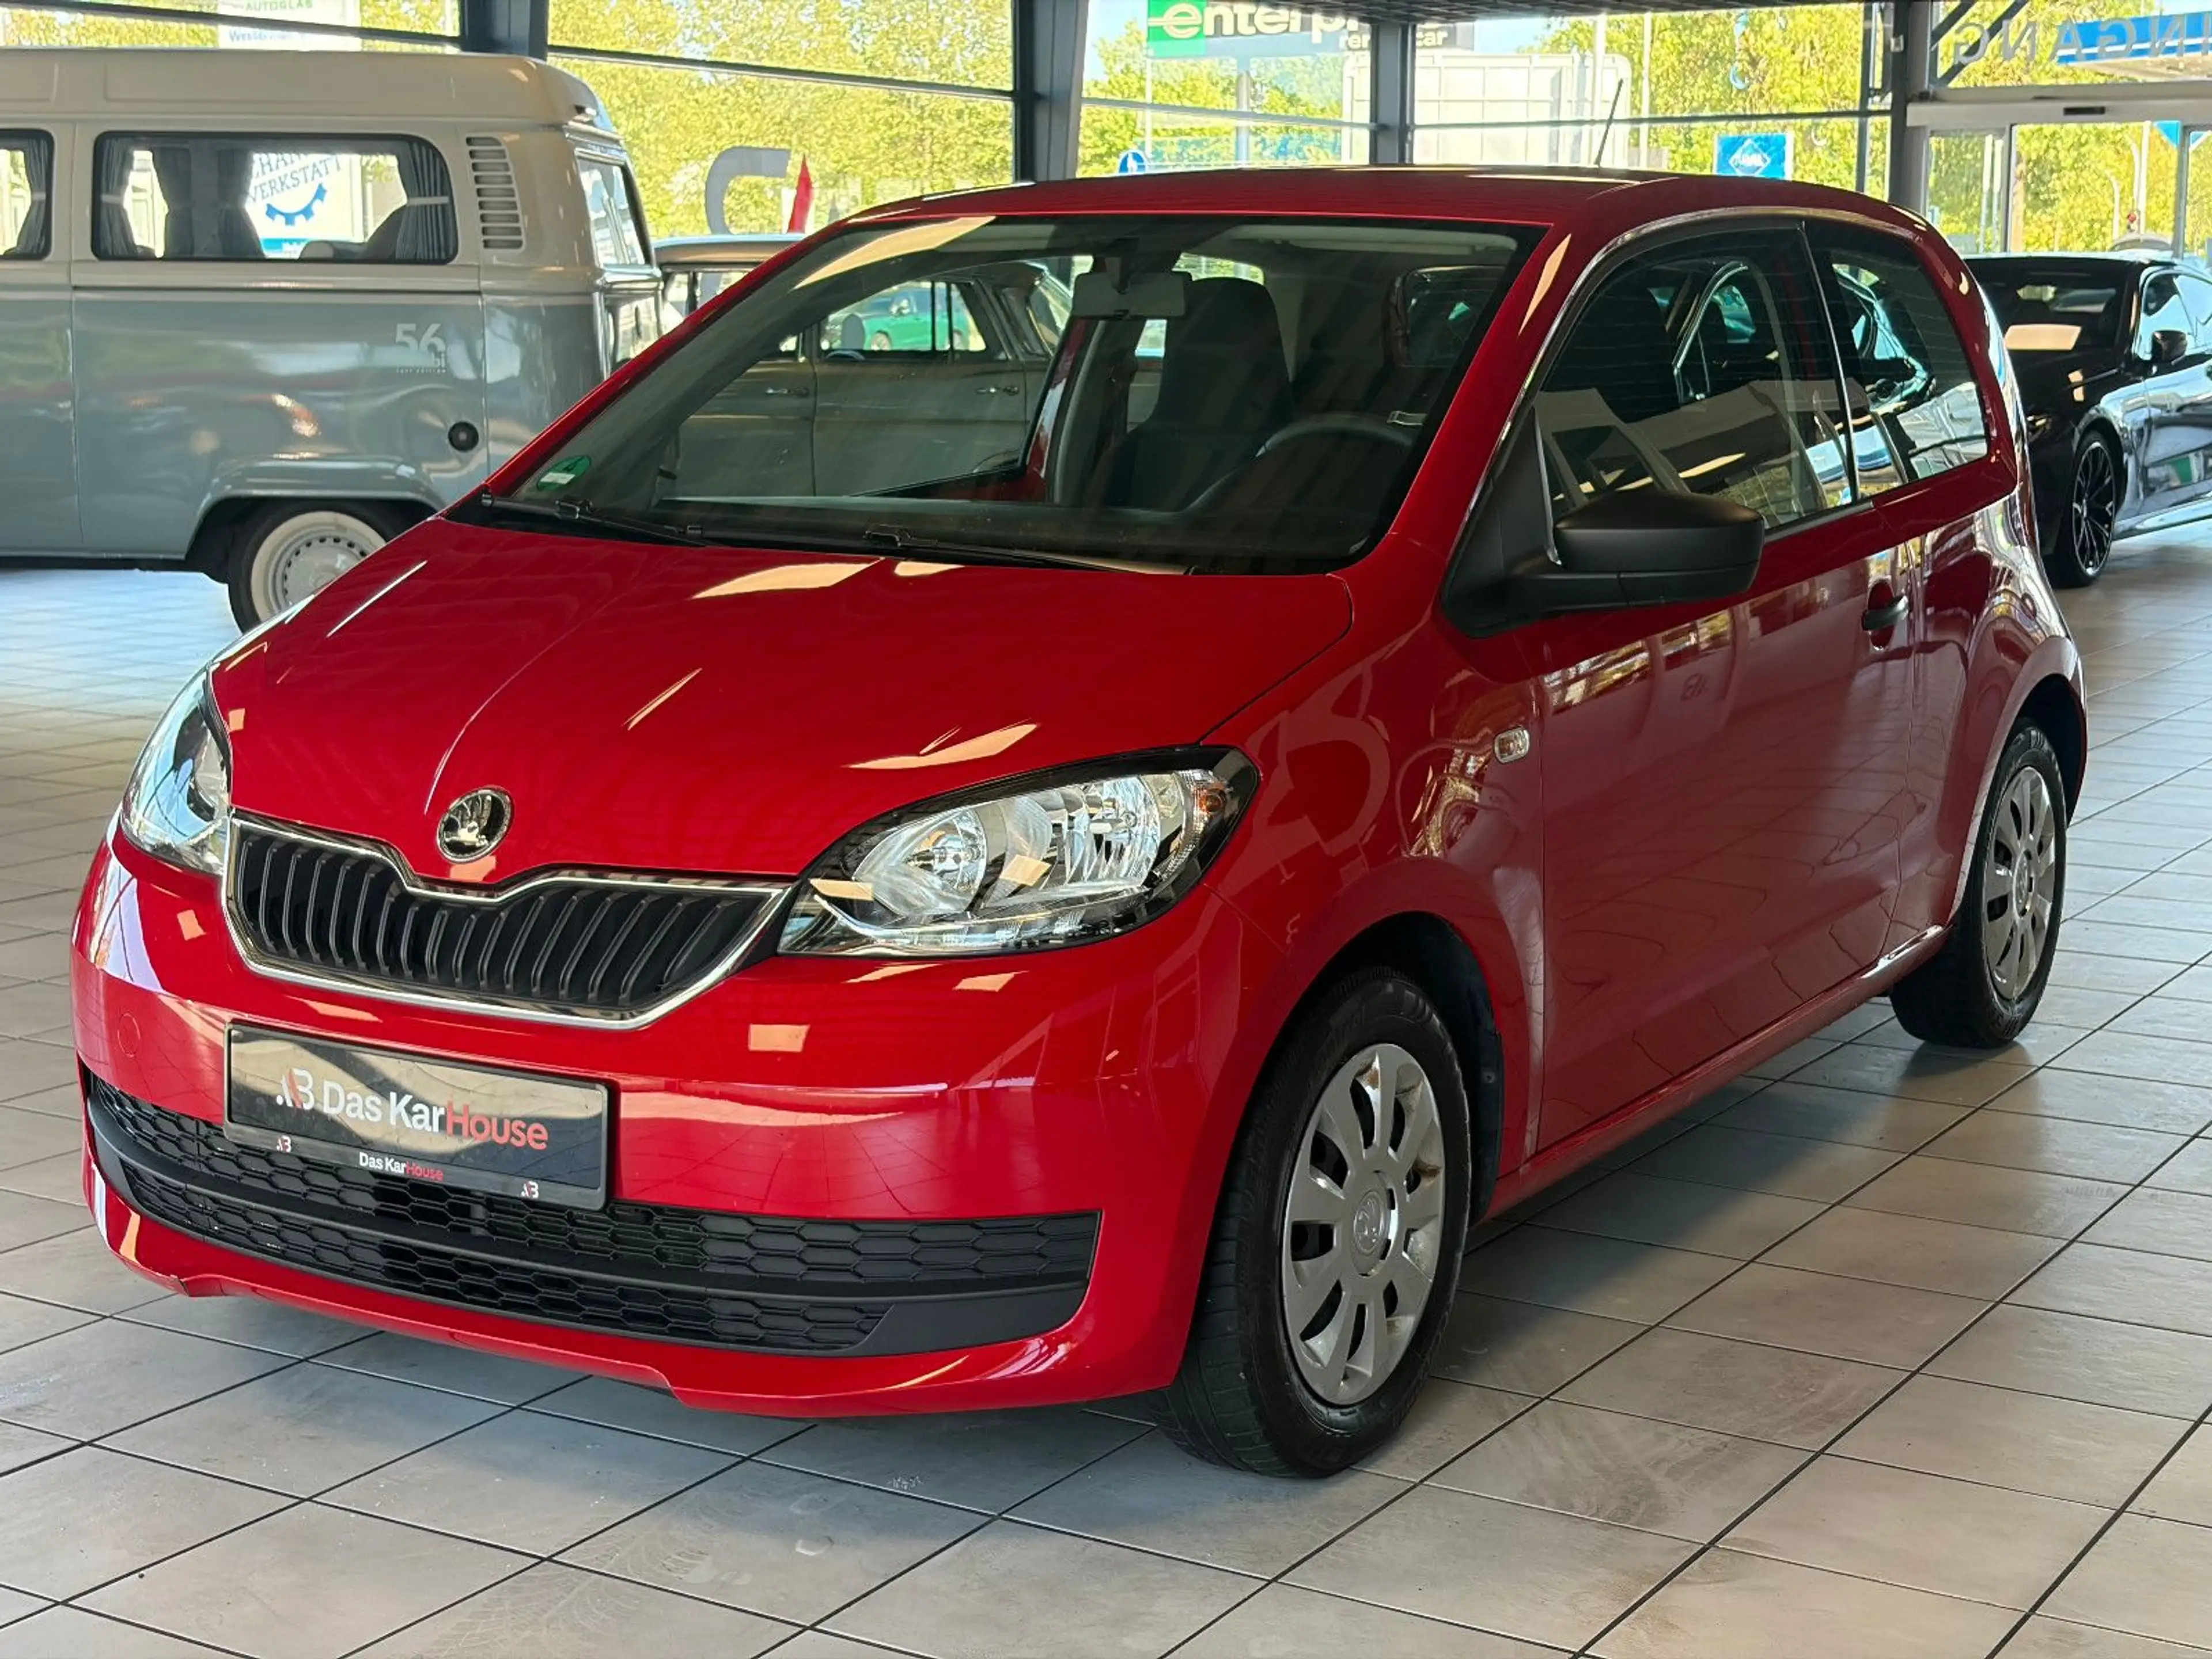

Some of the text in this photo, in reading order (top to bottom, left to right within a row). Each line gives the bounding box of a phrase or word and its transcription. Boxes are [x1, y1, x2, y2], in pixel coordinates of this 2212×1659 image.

[322, 1080, 382, 1123] Das
[389, 1090, 549, 1150] KarHouse
[358, 1152, 444, 1181] Das KarHouse
